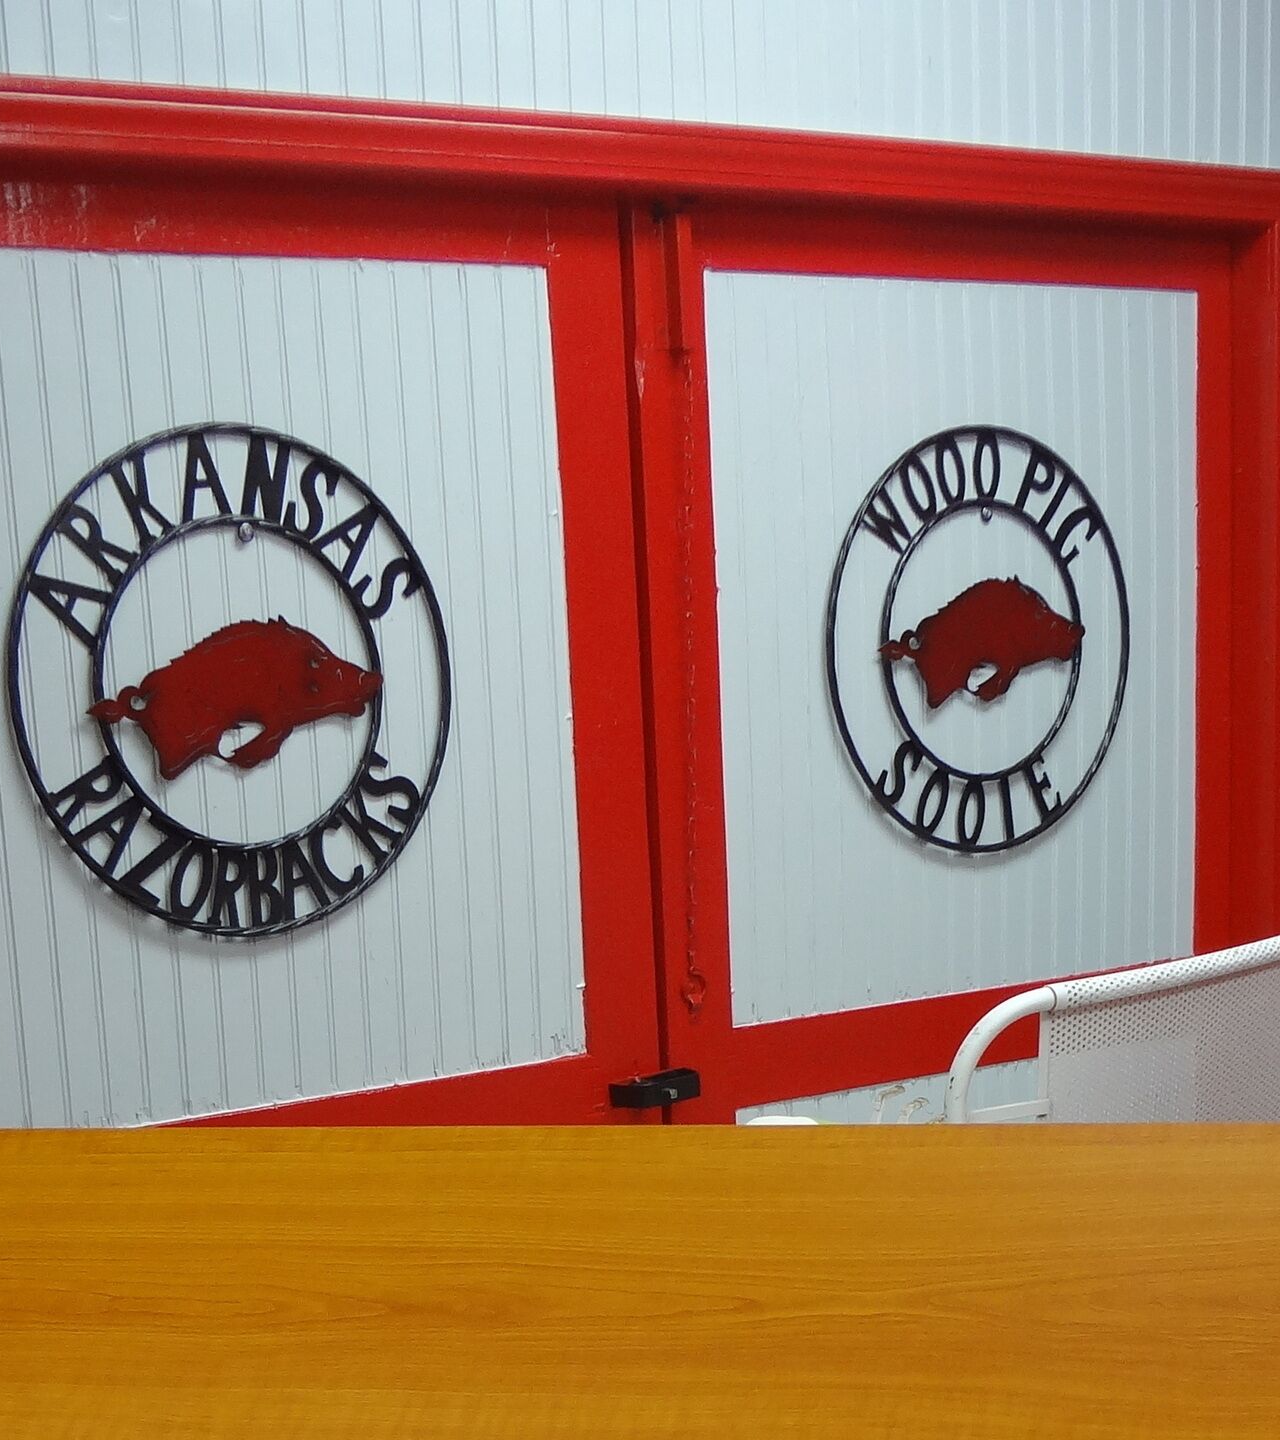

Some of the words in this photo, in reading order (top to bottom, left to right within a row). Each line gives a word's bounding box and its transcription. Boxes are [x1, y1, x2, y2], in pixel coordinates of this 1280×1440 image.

[28, 432, 423, 655] ARKANSAS
[860, 431, 1001, 554] WOOO
[1014, 446, 1103, 568] PIG
[51, 754, 423, 930] RAZORBACKS
[875, 740, 1063, 847] SOOIE
